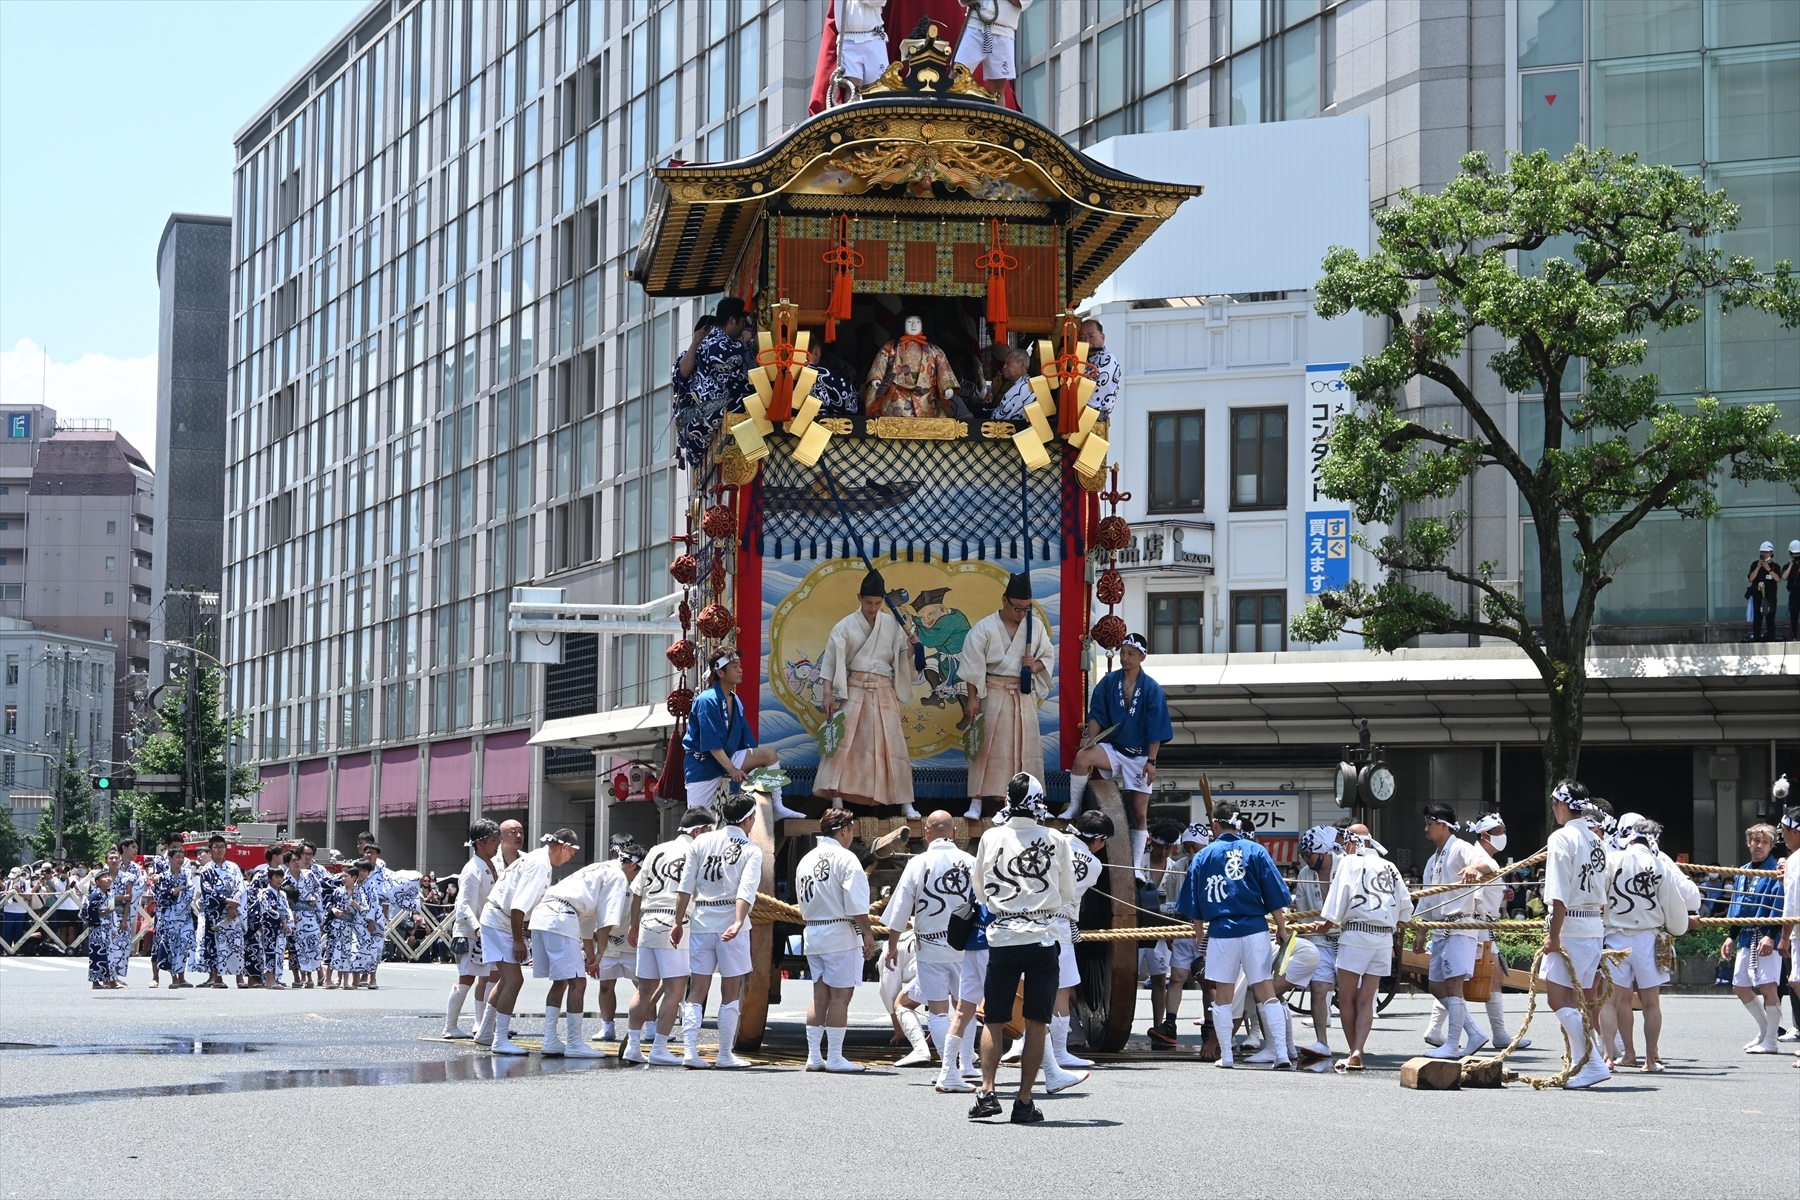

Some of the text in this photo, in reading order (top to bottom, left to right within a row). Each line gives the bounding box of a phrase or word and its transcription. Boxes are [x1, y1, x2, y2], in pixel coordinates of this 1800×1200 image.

[1173, 527, 1211, 564] ikezen
[1309, 518, 1327, 592] 買えます
[1329, 519, 1344, 557] すぐ
